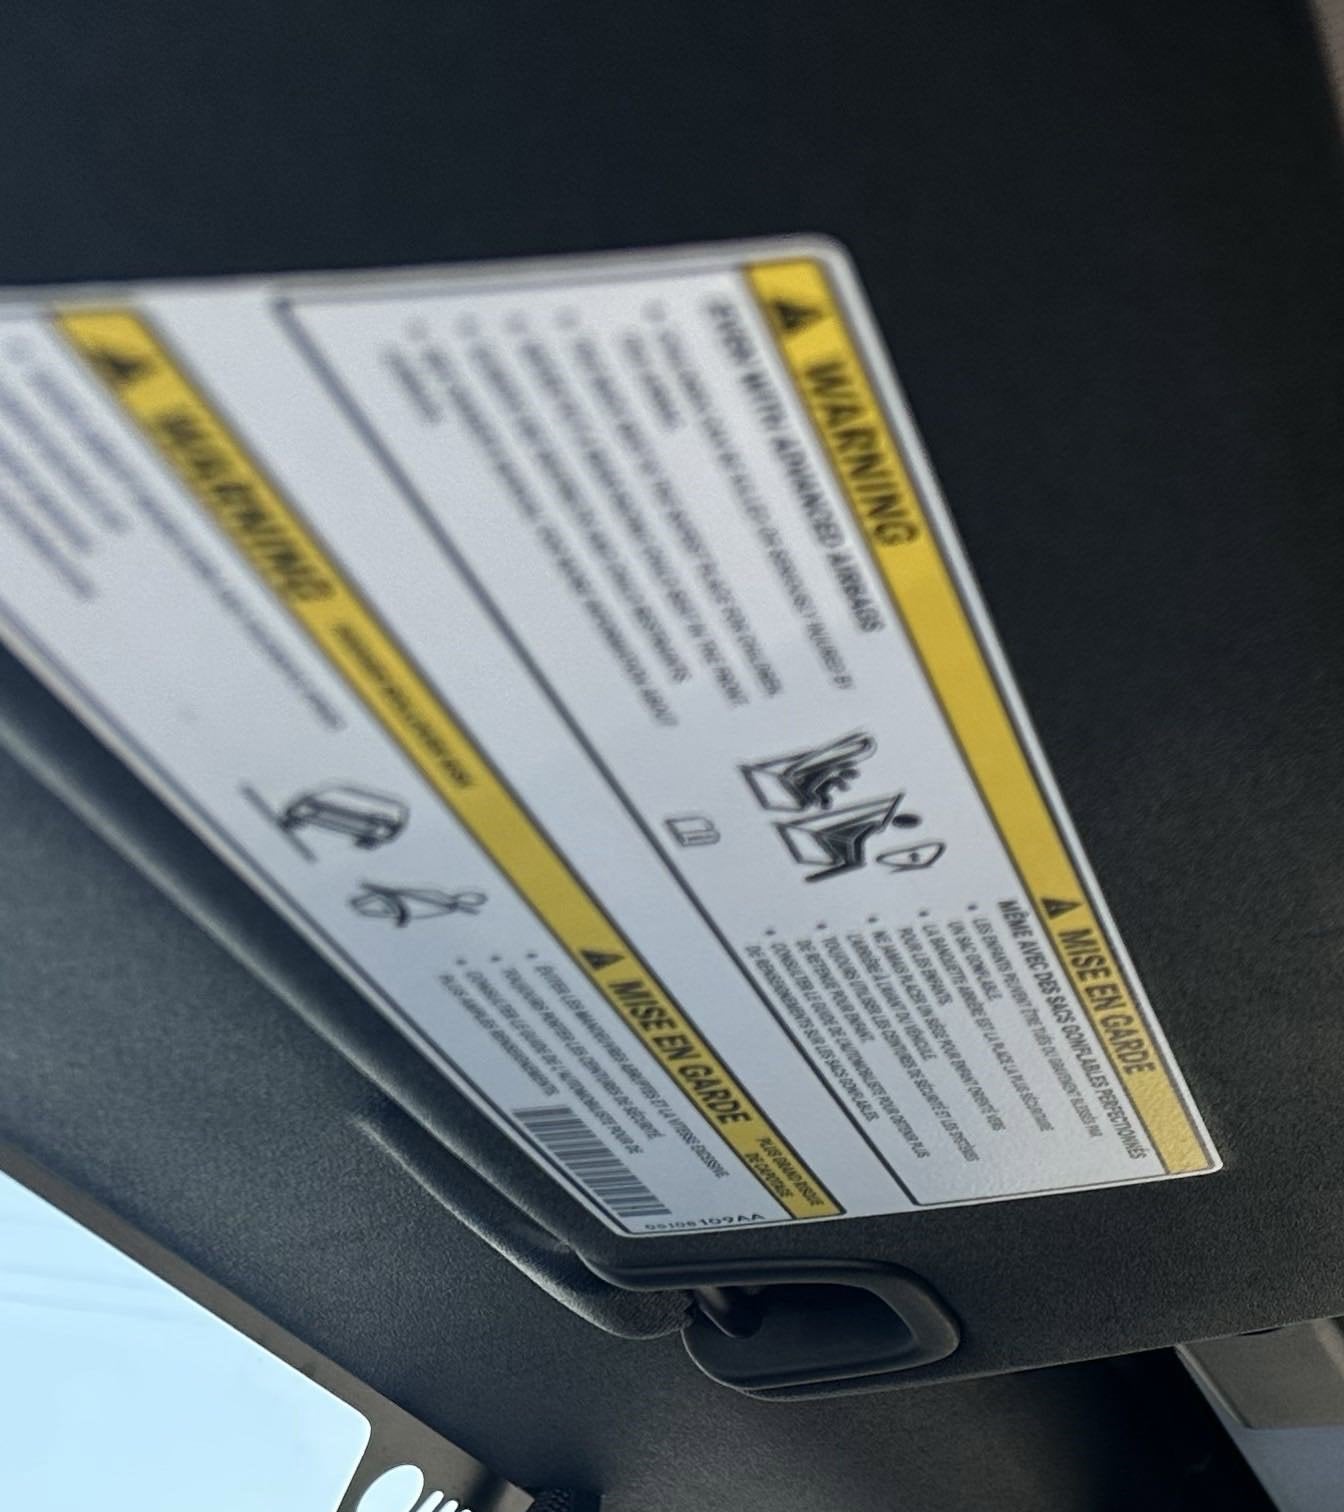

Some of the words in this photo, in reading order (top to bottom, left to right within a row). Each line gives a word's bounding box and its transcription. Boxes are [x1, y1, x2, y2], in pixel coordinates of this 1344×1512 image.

[796, 358, 924, 547] WARNING
[135, 406, 340, 602] WARNING
[737, 370, 793, 430] WITH
[768, 435, 849, 548] ADVANCED
[825, 551, 890, 634] AIRBAGS
[998, 899, 1037, 937] MÊME
[982, 934, 1015, 972] ENFANTS
[1018, 939, 1054, 971] AVEC
[1058, 926, 1114, 982] MISE
[607, 980, 679, 1030] MISE
[1035, 971, 1066, 994] DES
[1084, 982, 1127, 1010] EN
[1047, 994, 1081, 1023] SACS
[651, 1033, 702, 1060] EN
[1062, 1023, 1113, 1088] GONFLABLES
[1099, 1012, 1156, 1074] GARDE
[676, 1063, 753, 1124] GARDE
[1096, 1087, 1149, 1159] PERFECTIONNÉS
[745, 1153, 765, 1163] DE
[754, 1163, 794, 1198] CAPOTAGE
[756, 1137, 782, 1156] PLUS
[772, 1156, 803, 1181] GRAND
[792, 1181, 824, 1206] RISQUE
